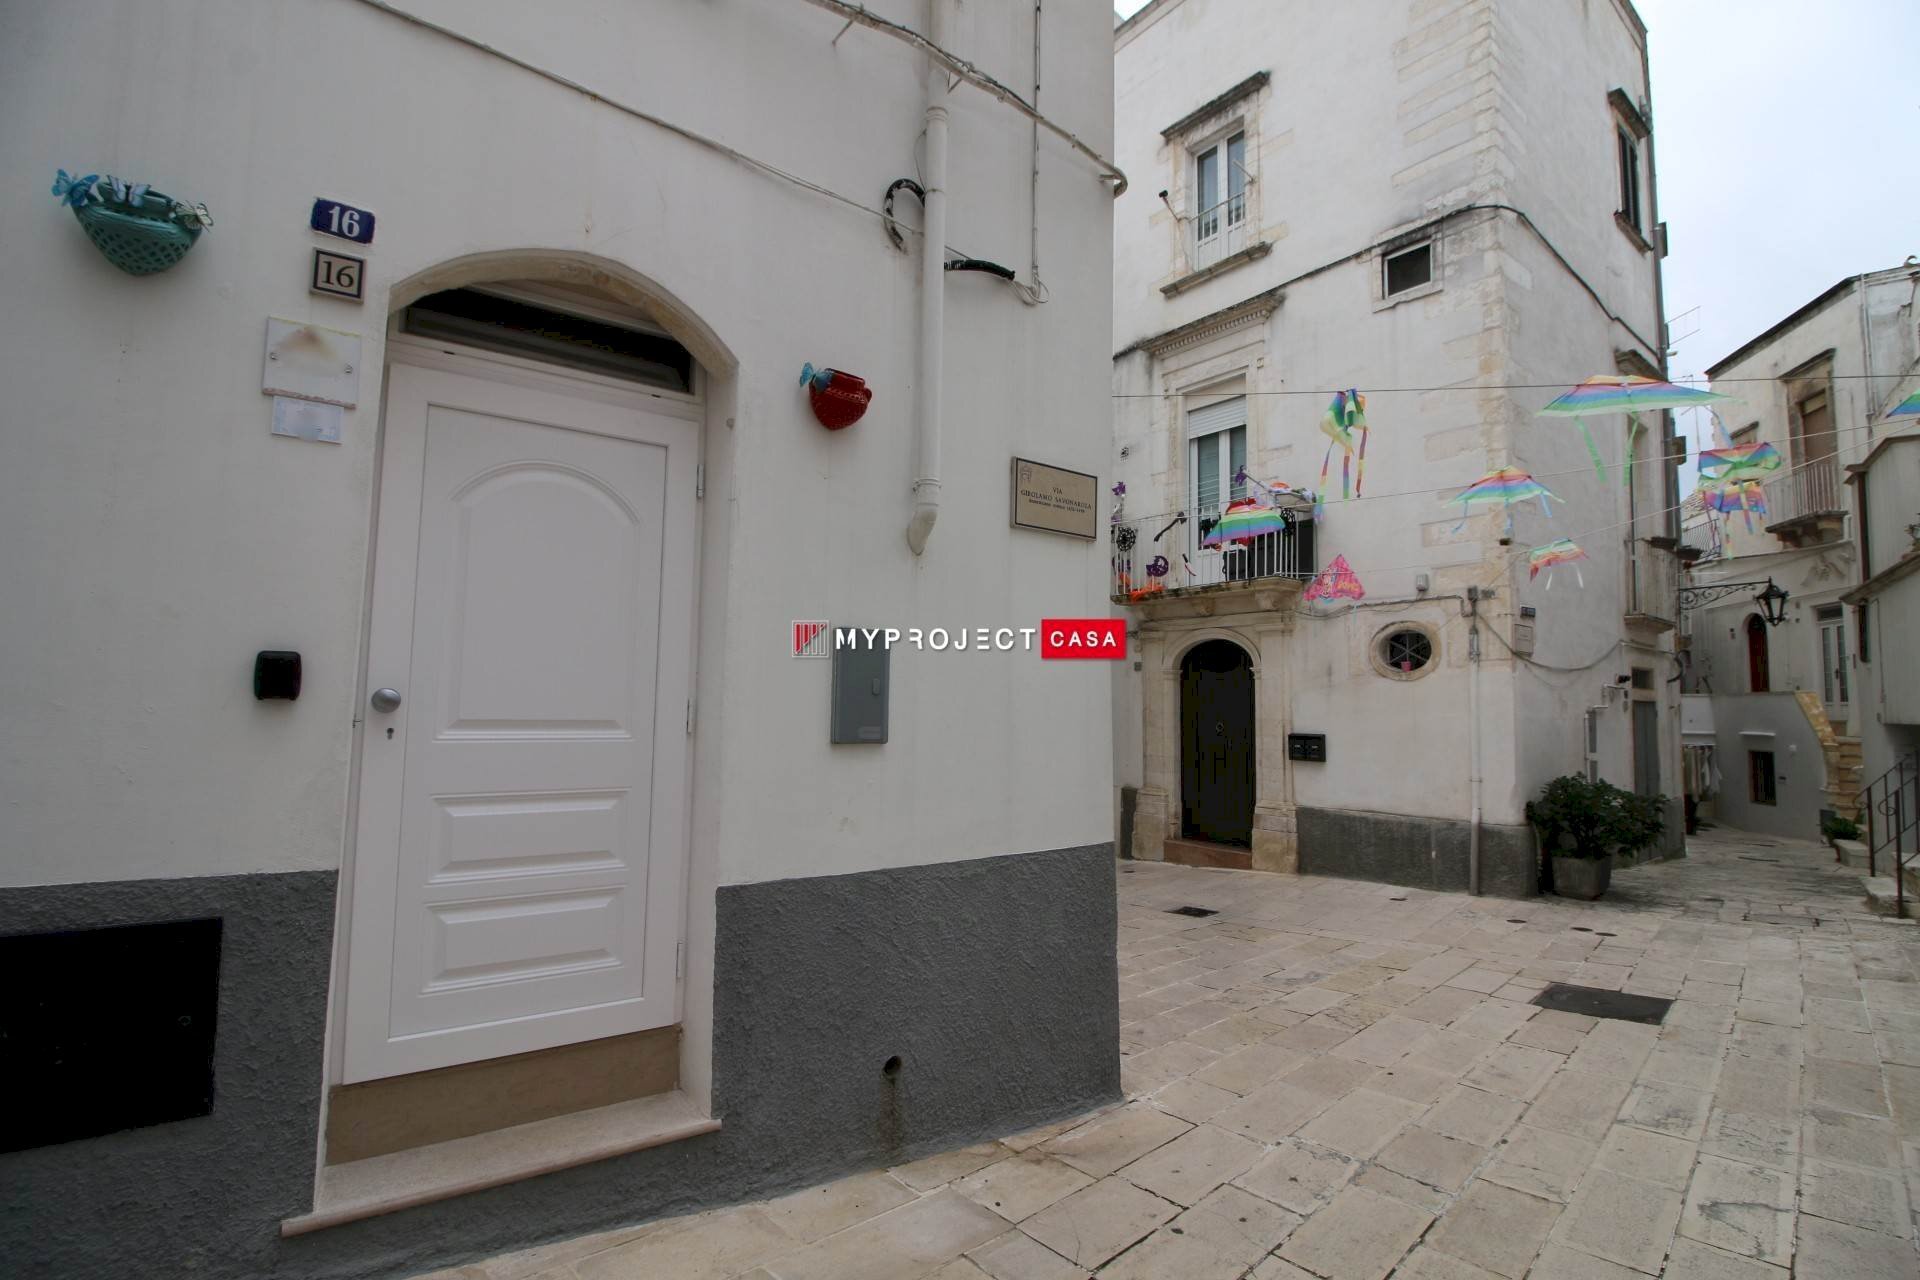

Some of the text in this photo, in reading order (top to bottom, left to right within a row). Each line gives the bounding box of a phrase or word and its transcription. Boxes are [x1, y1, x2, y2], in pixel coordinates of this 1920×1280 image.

[328, 205, 360, 238] 16
[322, 260, 355, 288] 16
[1020, 489, 1053, 501] GIROLAMO
[1055, 497, 1092, 510] SAVONAROLA
[1052, 487, 1063, 495] VIA
